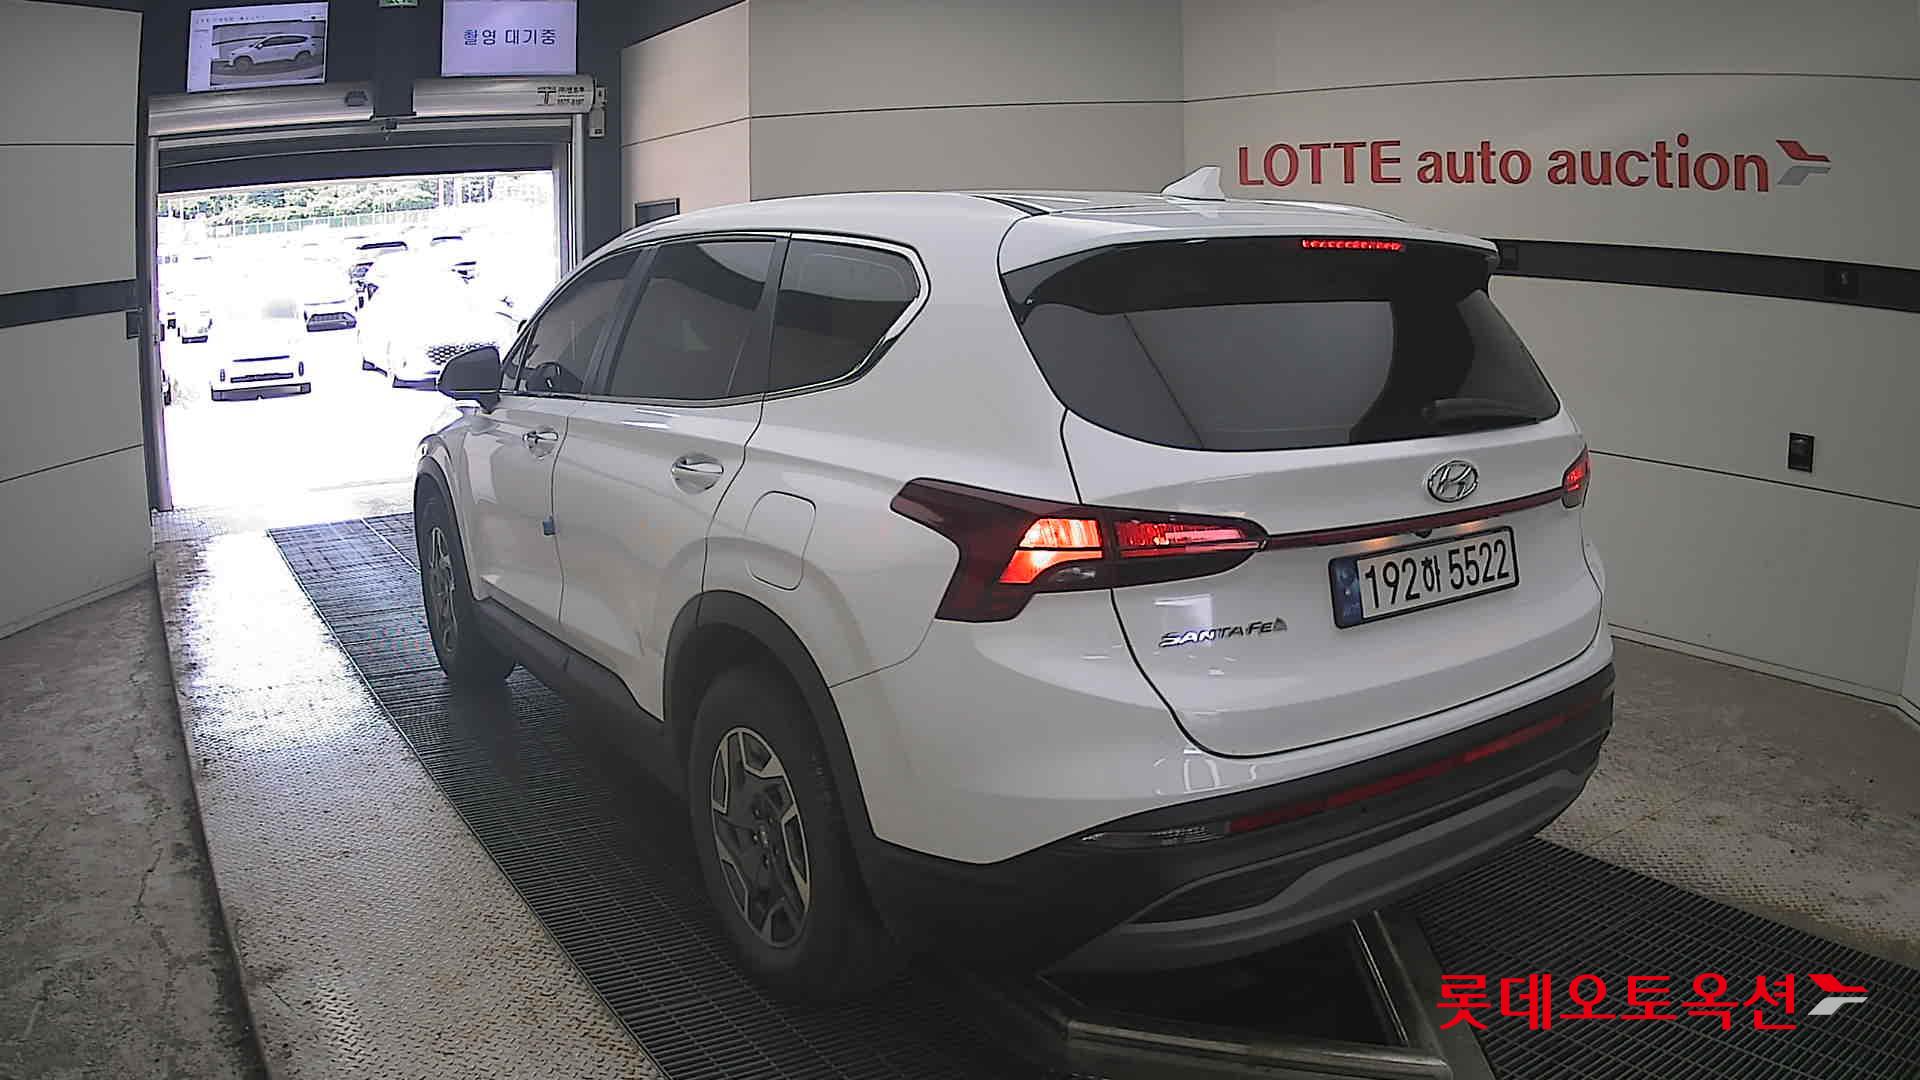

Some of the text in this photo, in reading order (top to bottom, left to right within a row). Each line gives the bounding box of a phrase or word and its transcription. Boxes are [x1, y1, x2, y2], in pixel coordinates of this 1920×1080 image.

[505, 29, 557, 46] 대기중
[1238, 132, 1769, 192] LOTTE auto auction
[1365, 539, 1509, 609] 192하 5522
